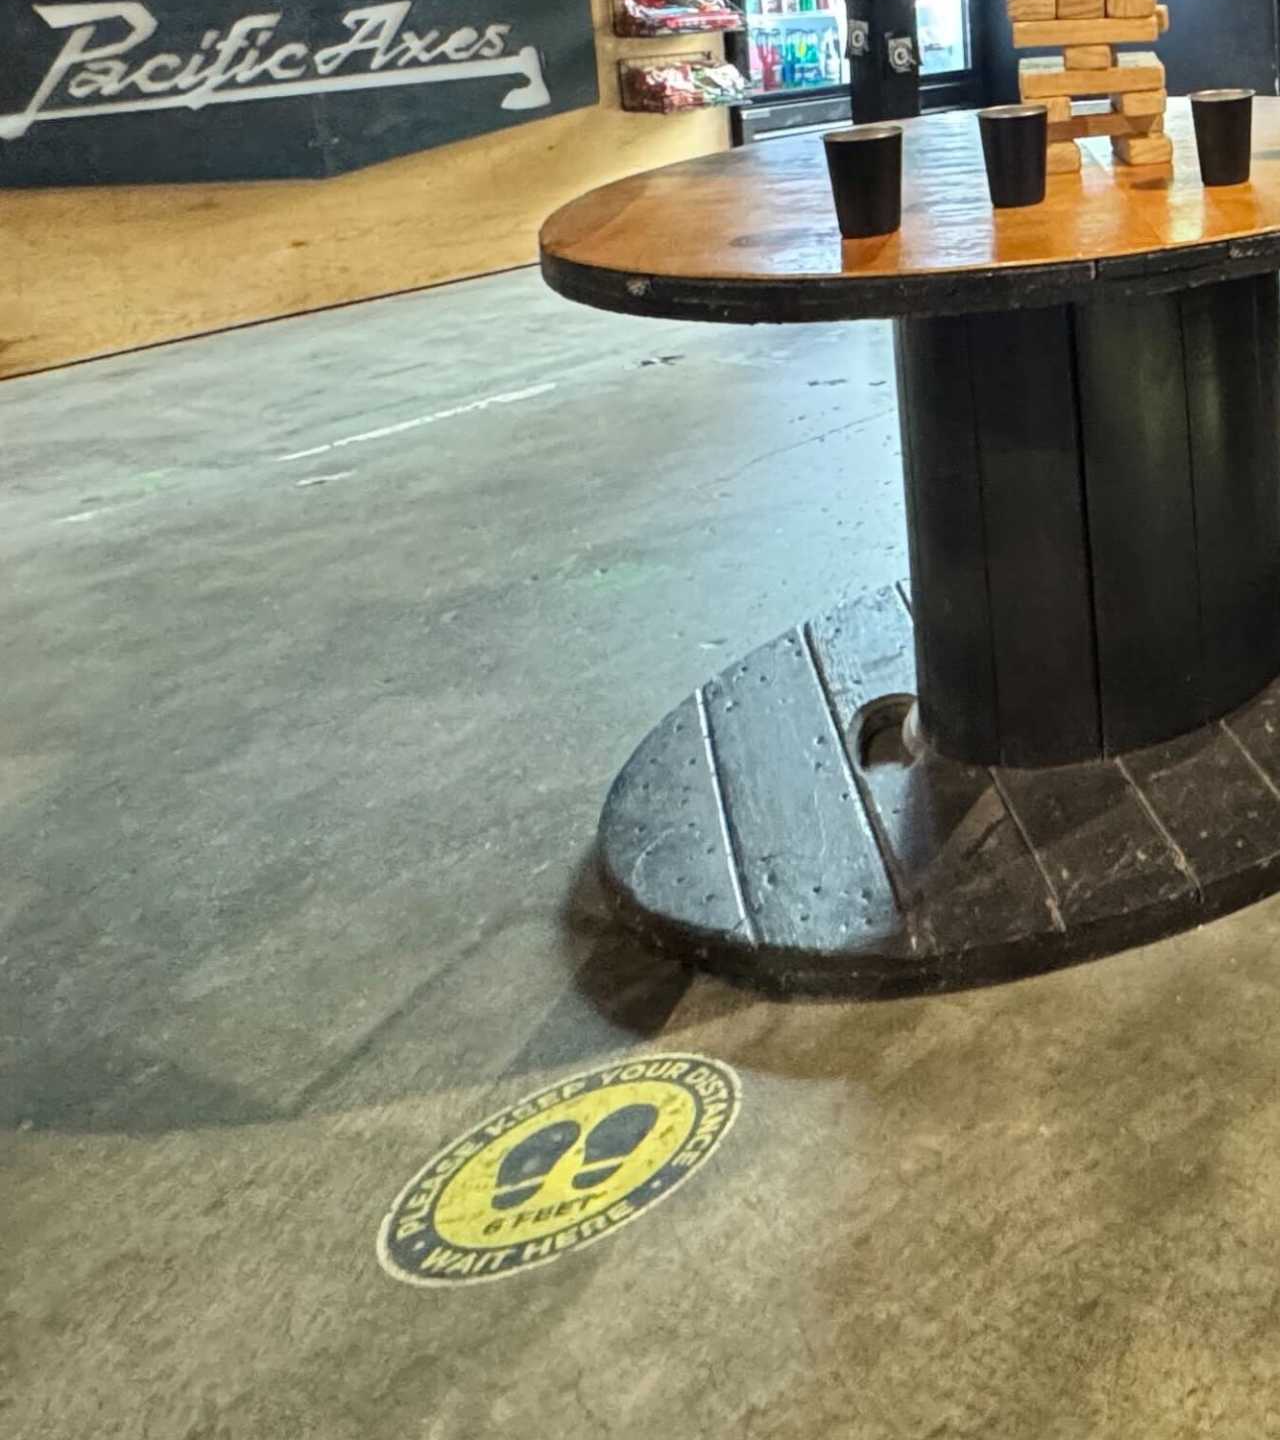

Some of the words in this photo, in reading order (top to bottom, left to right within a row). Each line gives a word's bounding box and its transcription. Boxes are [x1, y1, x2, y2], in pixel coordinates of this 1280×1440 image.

[28, 1, 309, 120] Pacific
[316, 0, 512, 75] Axes
[600, 1061, 690, 1086] YOUR
[679, 1063, 728, 1167] DISTANCE
[421, 1246, 517, 1275] WAIT
[521, 1201, 638, 1262] HERE
[505, 1190, 609, 1230] FEET
